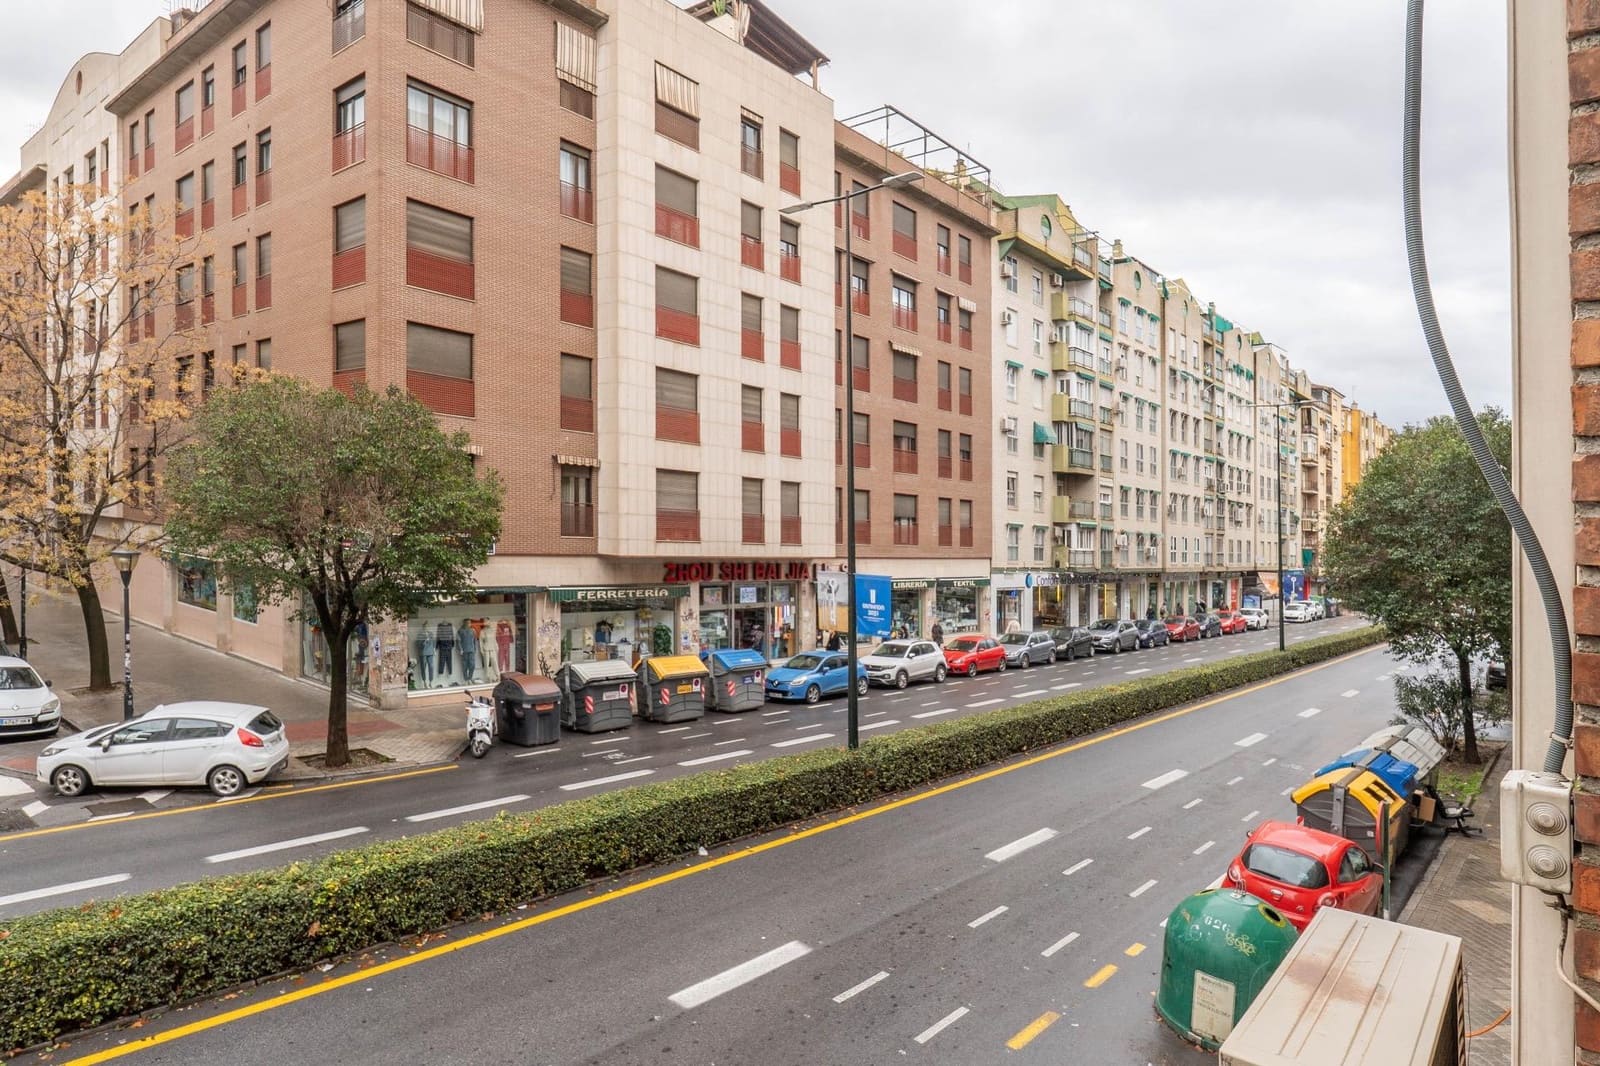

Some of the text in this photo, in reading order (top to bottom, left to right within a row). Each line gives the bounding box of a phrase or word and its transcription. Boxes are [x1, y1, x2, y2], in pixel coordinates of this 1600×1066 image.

[664, 562, 713, 583] ZHOU
[719, 562, 747, 580] SHI
[753, 562, 782, 580] BAI
[785, 562, 810, 580] JIA
[953, 580, 976, 588] TEXTIL
